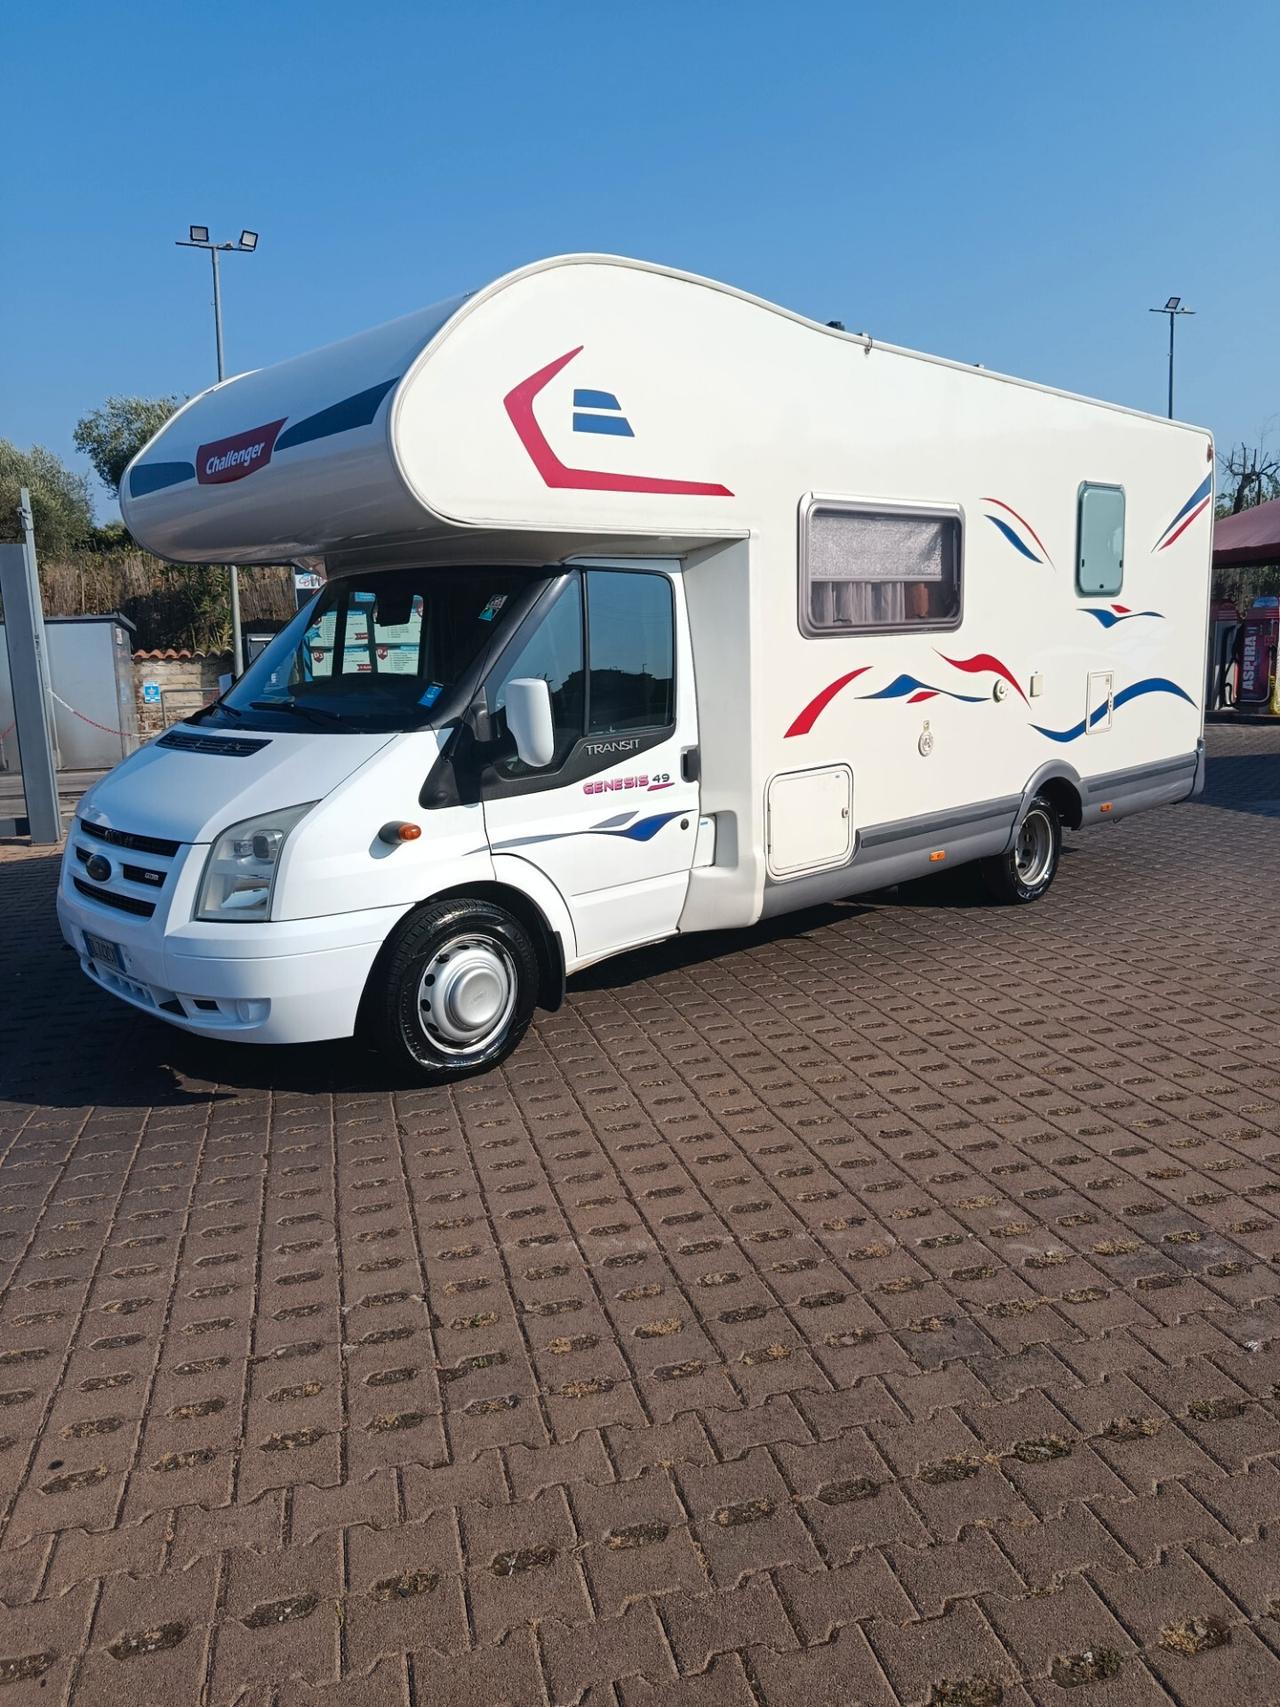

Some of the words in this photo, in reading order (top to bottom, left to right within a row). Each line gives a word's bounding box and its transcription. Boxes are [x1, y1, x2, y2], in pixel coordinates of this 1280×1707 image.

[206, 442, 265, 475] Challenger
[1242, 636, 1257, 690] ASPIRA
[586, 740, 640, 756] TRANSIT
[583, 775, 649, 795] GENESIS
[652, 773, 670, 783] 49
